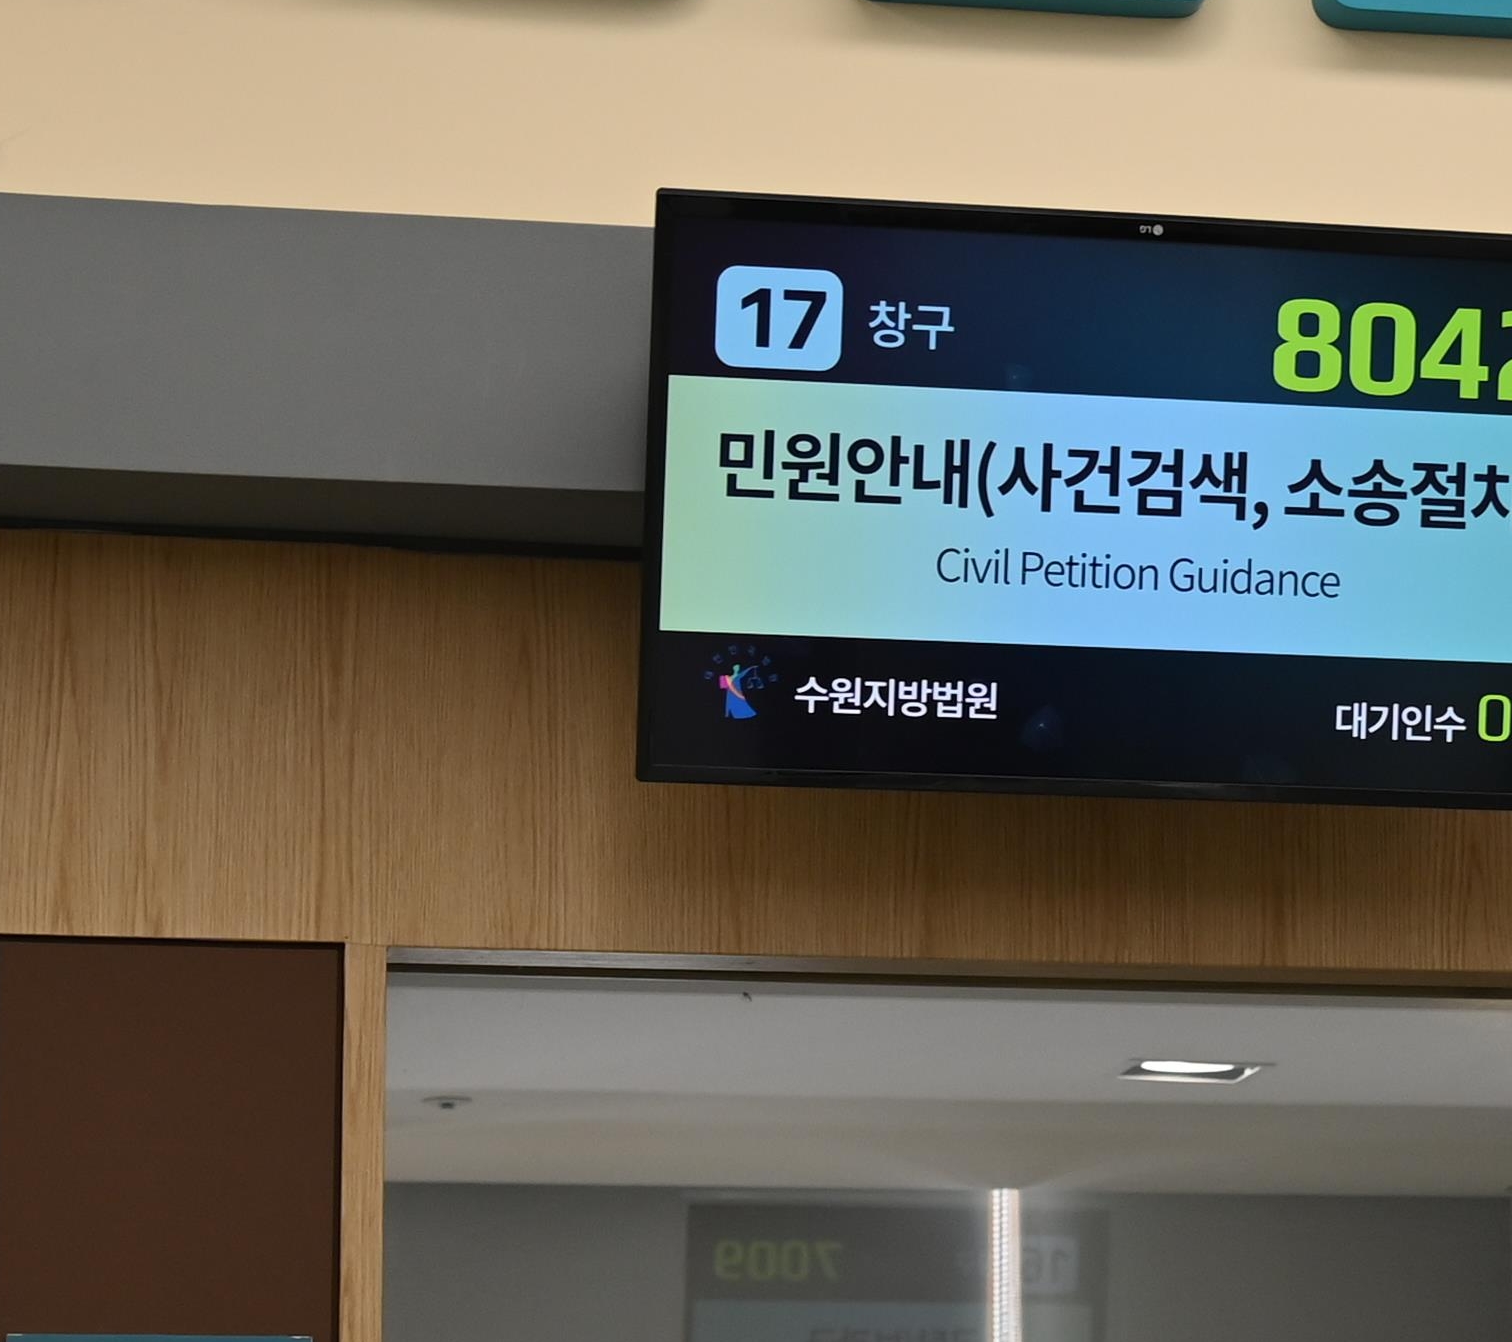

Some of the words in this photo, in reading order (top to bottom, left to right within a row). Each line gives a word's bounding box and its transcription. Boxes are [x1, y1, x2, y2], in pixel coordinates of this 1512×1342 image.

[739, 288, 829, 350] 17
[867, 300, 955, 351] 창구
[716, 428, 1270, 530] 민원안내(사건검색,
[935, 547, 1011, 587] Civil
[1019, 551, 1160, 592] Petition
[1167, 556, 1342, 601] Guidance
[793, 673, 999, 720] 수원지방법원
[1334, 700, 1466, 741] 대기인수
[1476, 692, 1512, 744] 0
